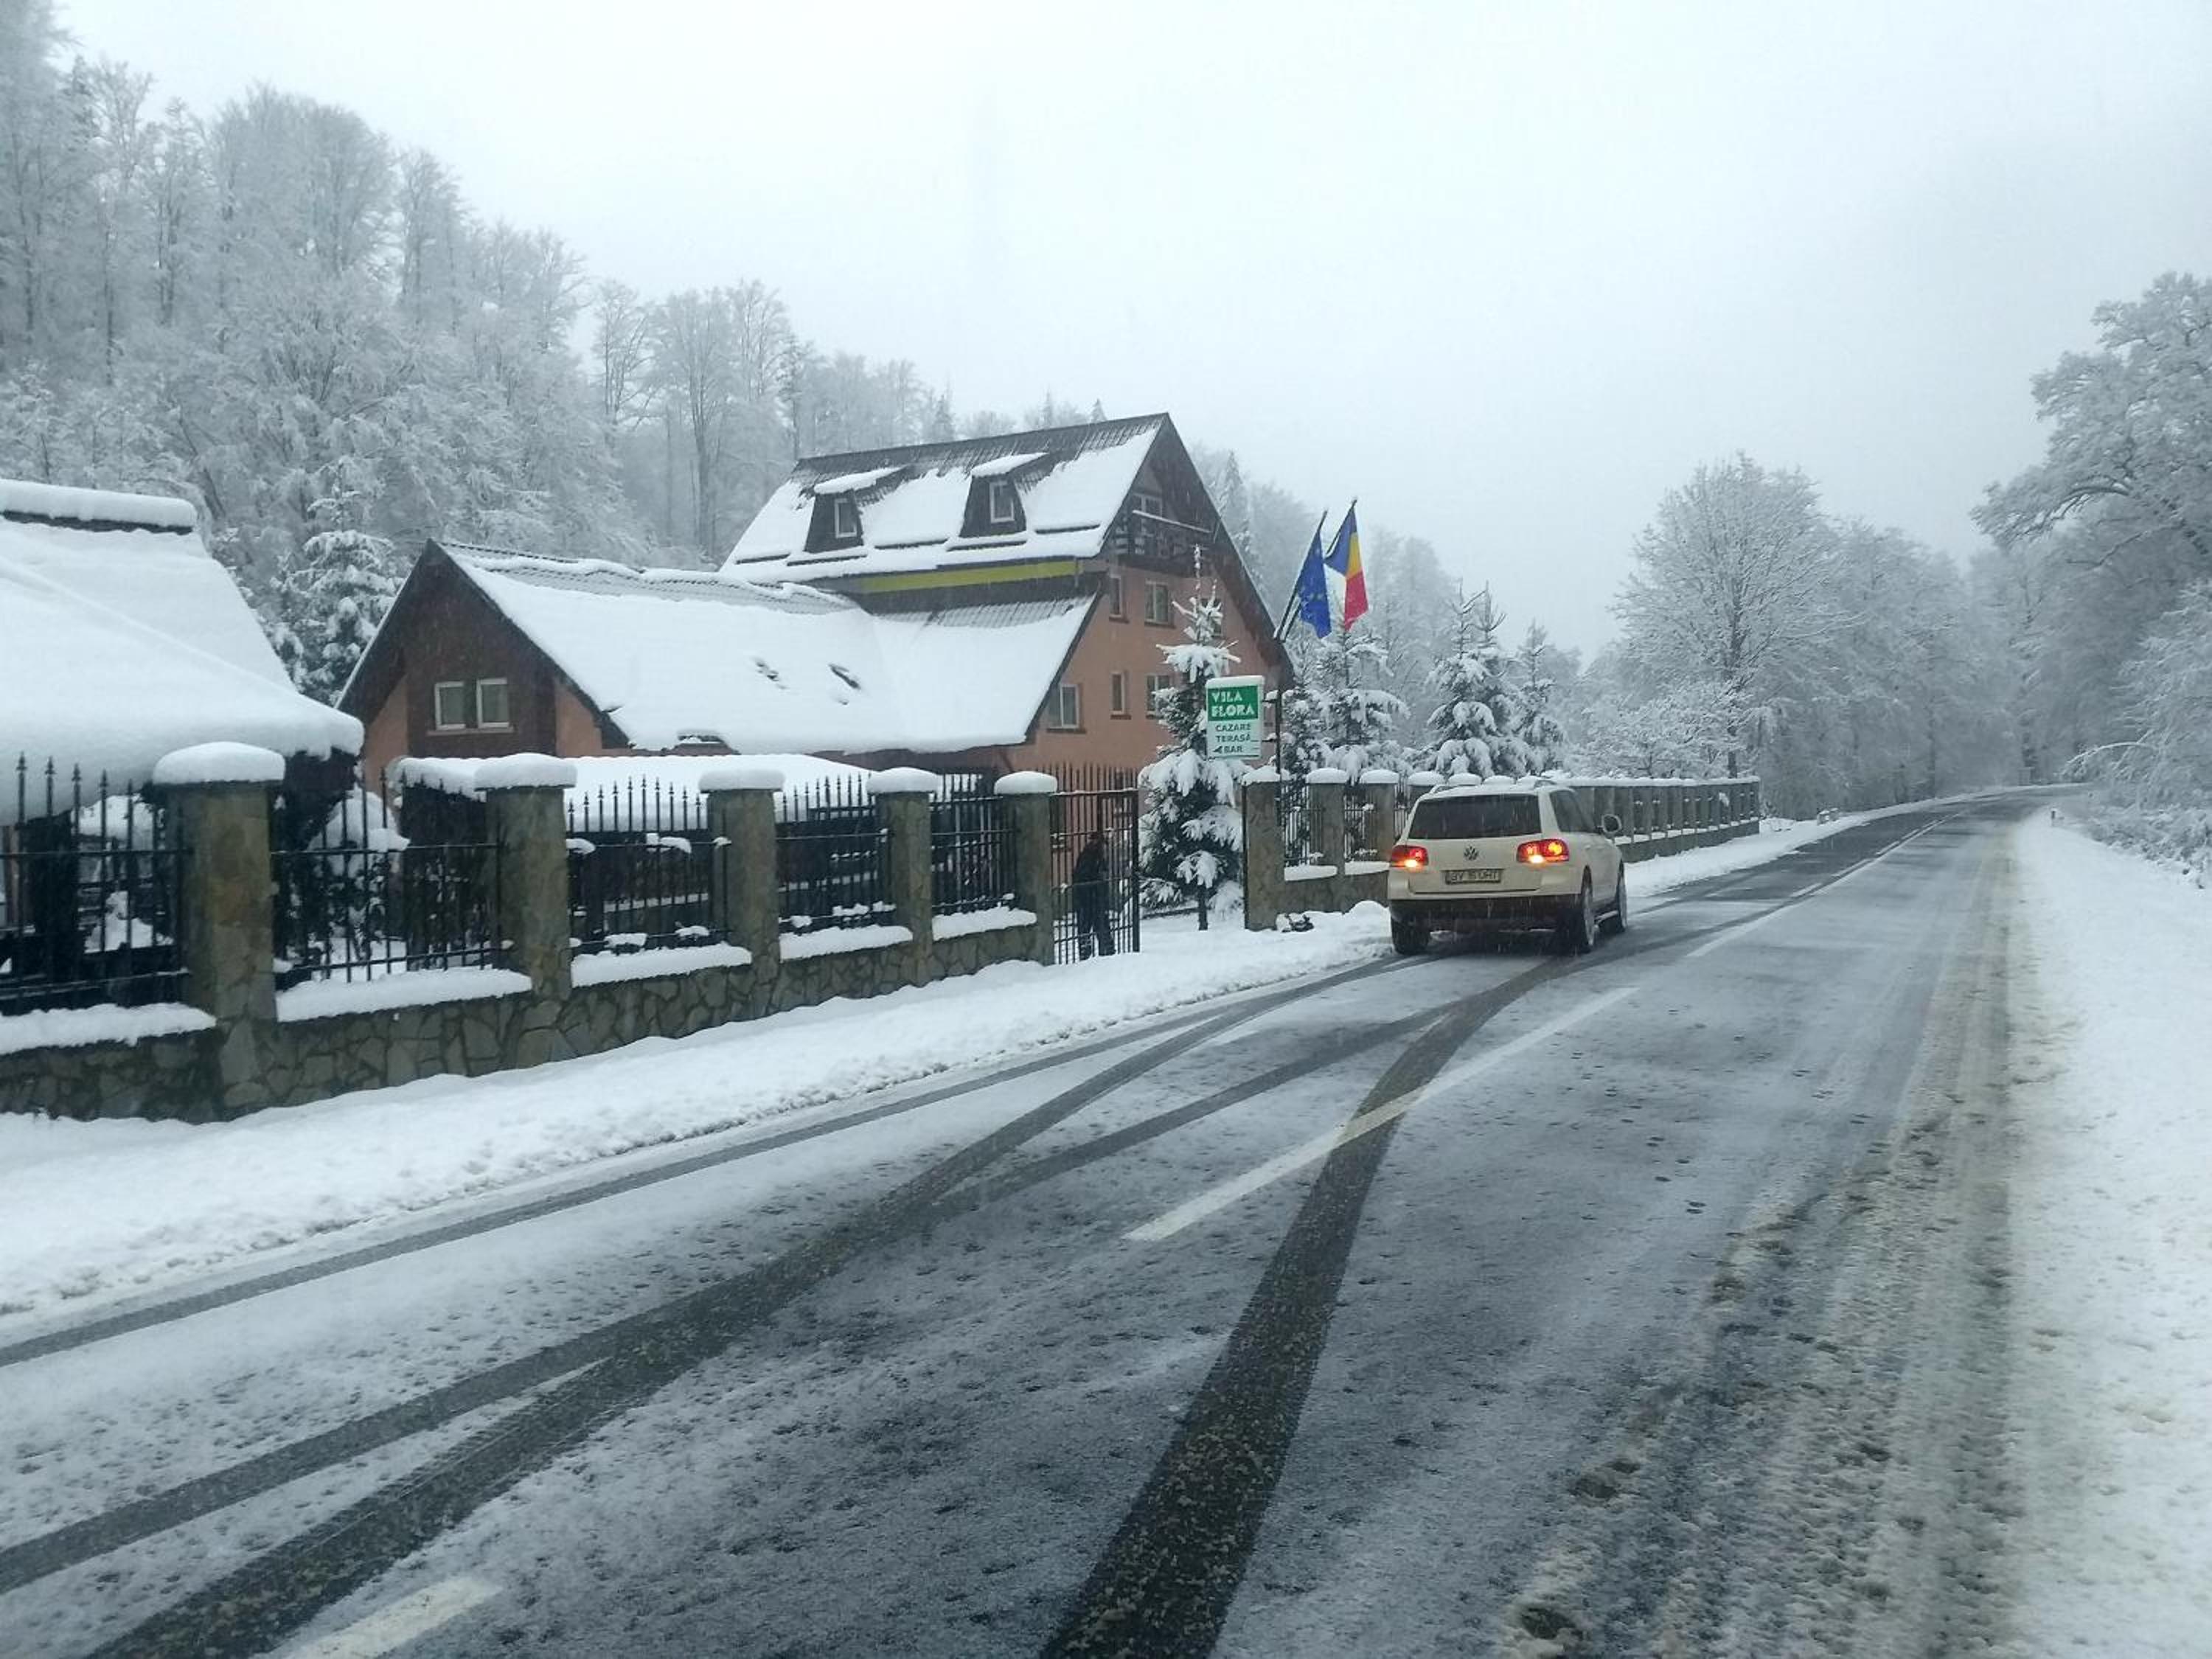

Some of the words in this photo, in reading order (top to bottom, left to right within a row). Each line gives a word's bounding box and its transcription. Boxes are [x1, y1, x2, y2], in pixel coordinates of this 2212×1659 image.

[1211, 691, 1242, 703] VILA
[1211, 703, 1255, 717] FLORA
[1215, 723, 1251, 732] CAZARE
